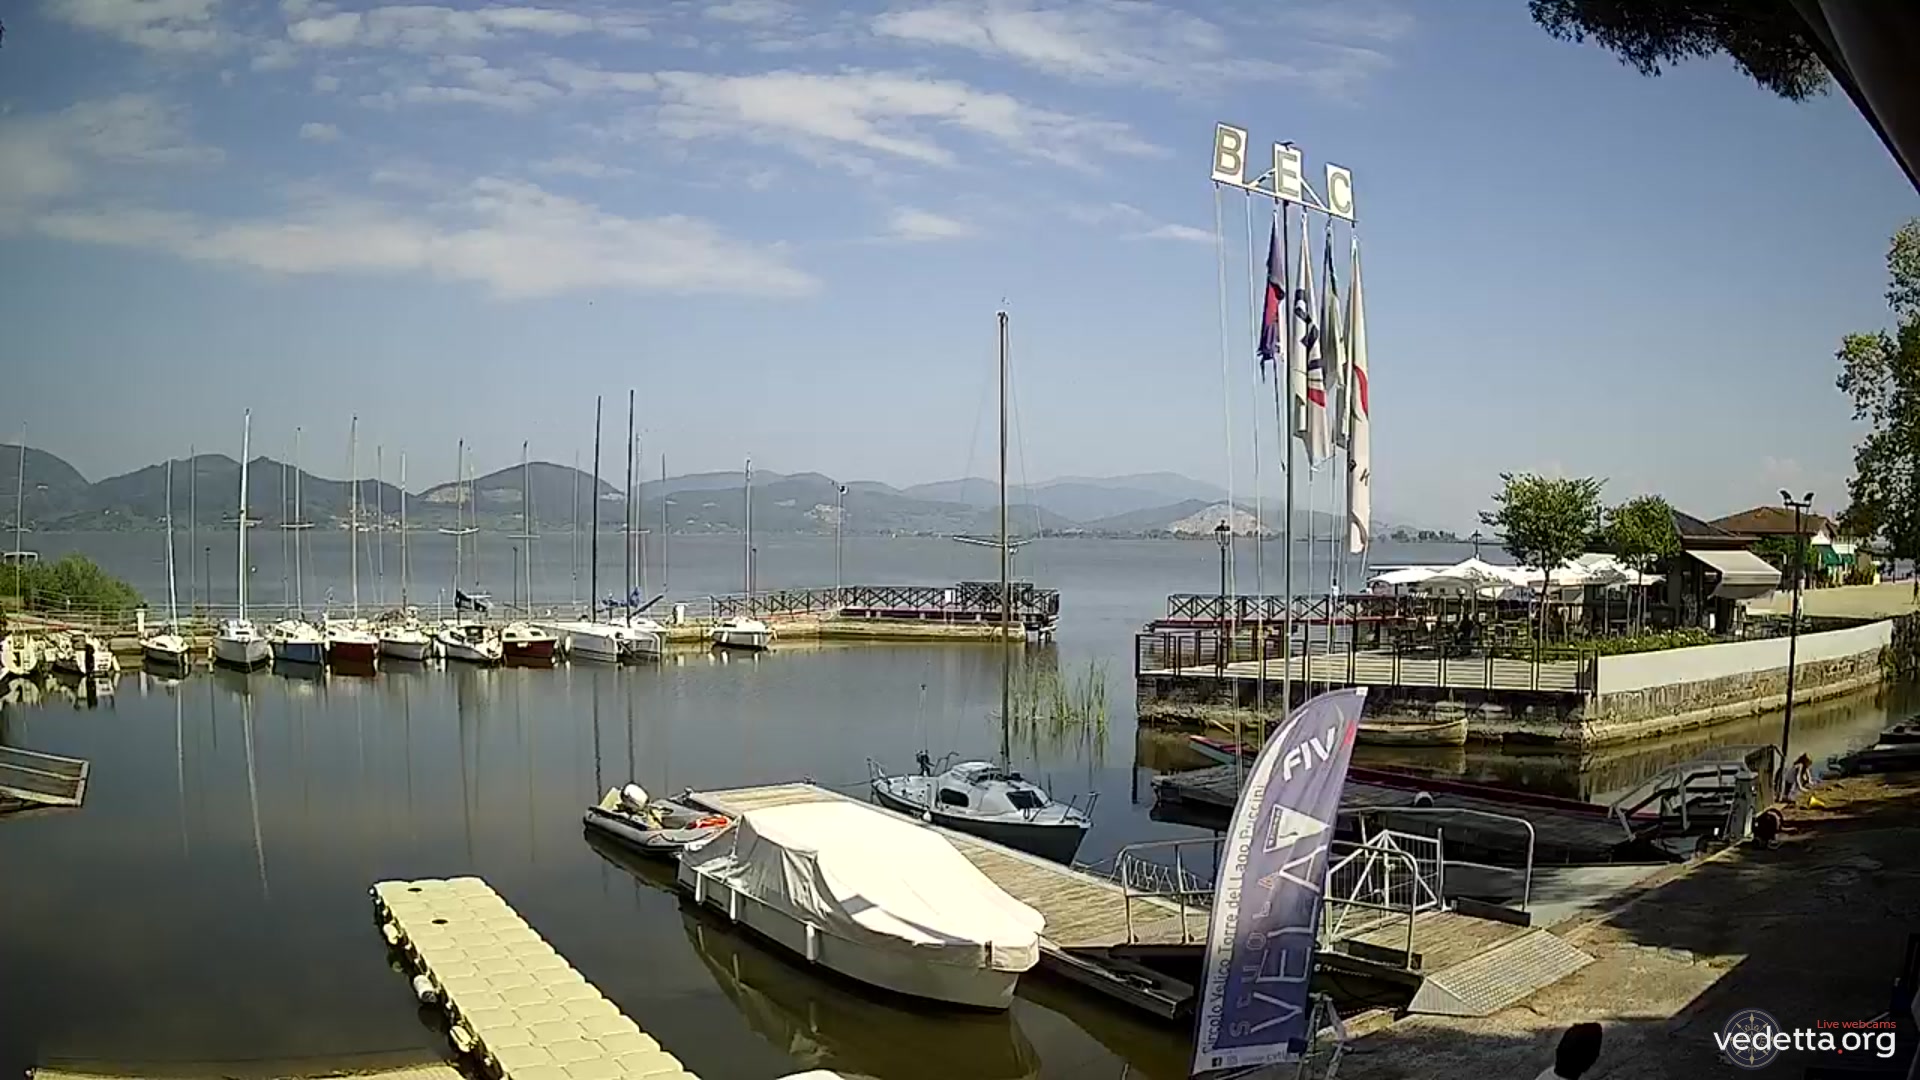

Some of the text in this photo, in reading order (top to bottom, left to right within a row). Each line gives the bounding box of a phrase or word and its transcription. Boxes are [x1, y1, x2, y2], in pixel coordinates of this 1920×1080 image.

[1283, 726, 1337, 782] FIV
[1226, 887, 1242, 909] del
[1218, 914, 1239, 955] Torre
[1250, 845, 1328, 1033] VELA
[1211, 958, 1232, 1004] Velico
